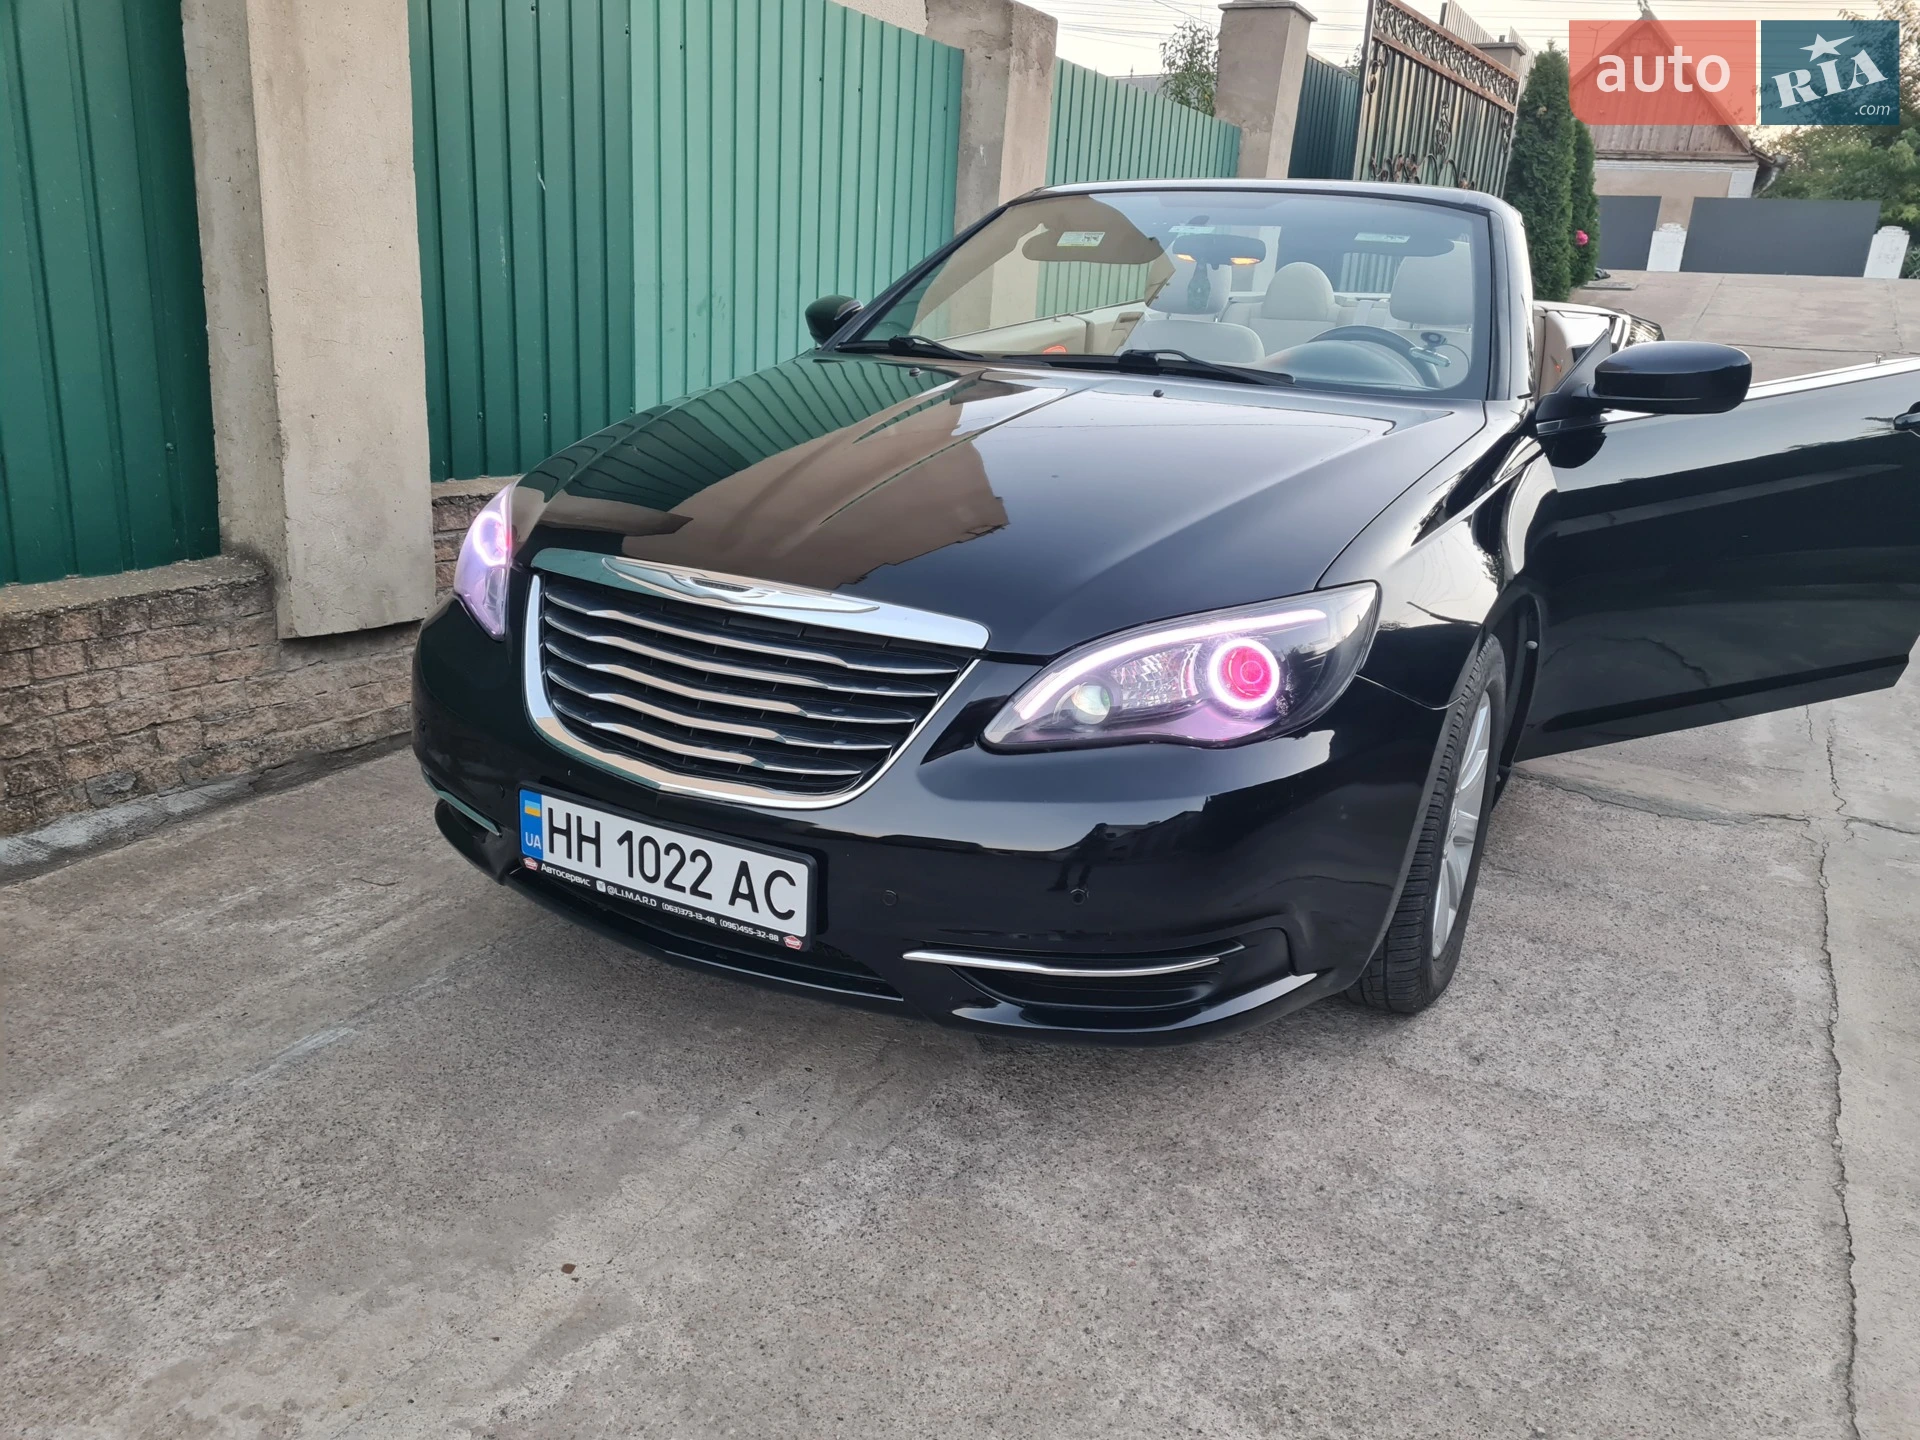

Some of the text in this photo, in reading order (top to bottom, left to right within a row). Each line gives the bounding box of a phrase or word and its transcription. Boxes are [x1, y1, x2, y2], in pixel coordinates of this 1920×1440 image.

[525, 831, 542, 850] UA
[548, 807, 796, 921] HH 1022 AC
